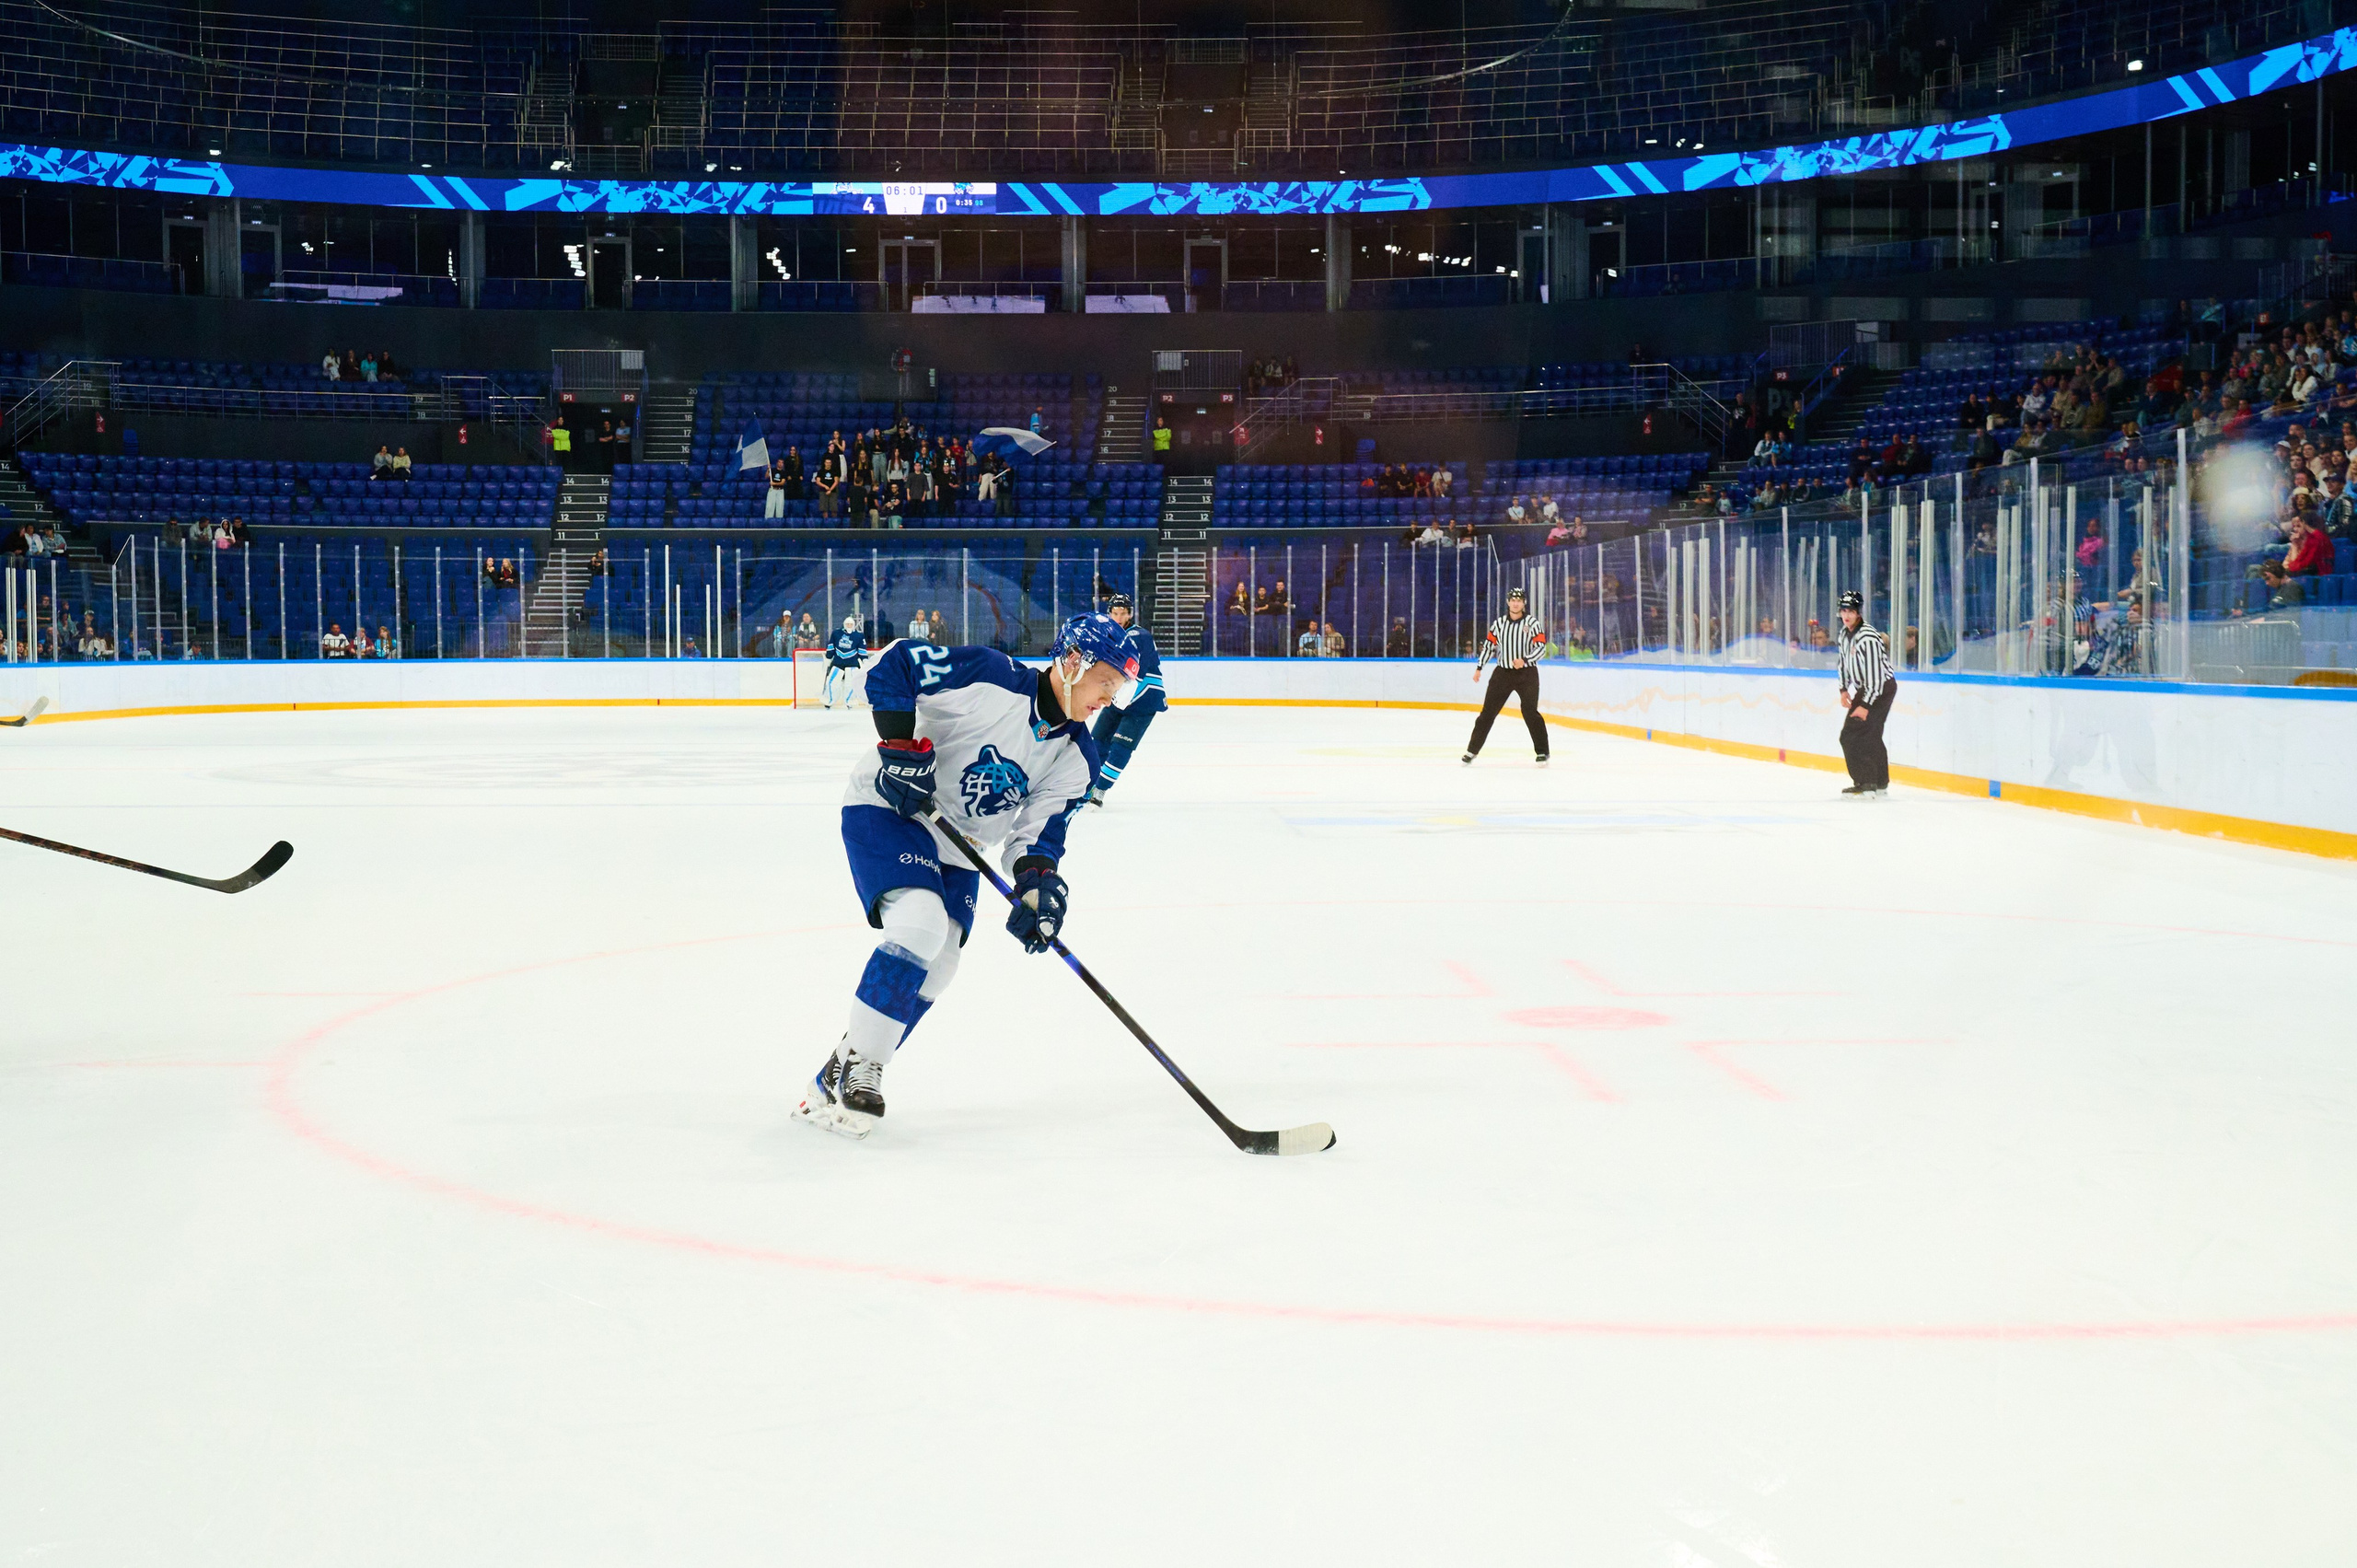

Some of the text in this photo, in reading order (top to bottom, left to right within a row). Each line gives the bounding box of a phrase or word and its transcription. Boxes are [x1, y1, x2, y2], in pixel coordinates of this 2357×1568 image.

[886, 186, 923, 196] 06:01
[863, 197, 876, 214] 4
[935, 197, 947, 214] 0
[17, 484, 27, 493] 13
[909, 645, 953, 687] 24
